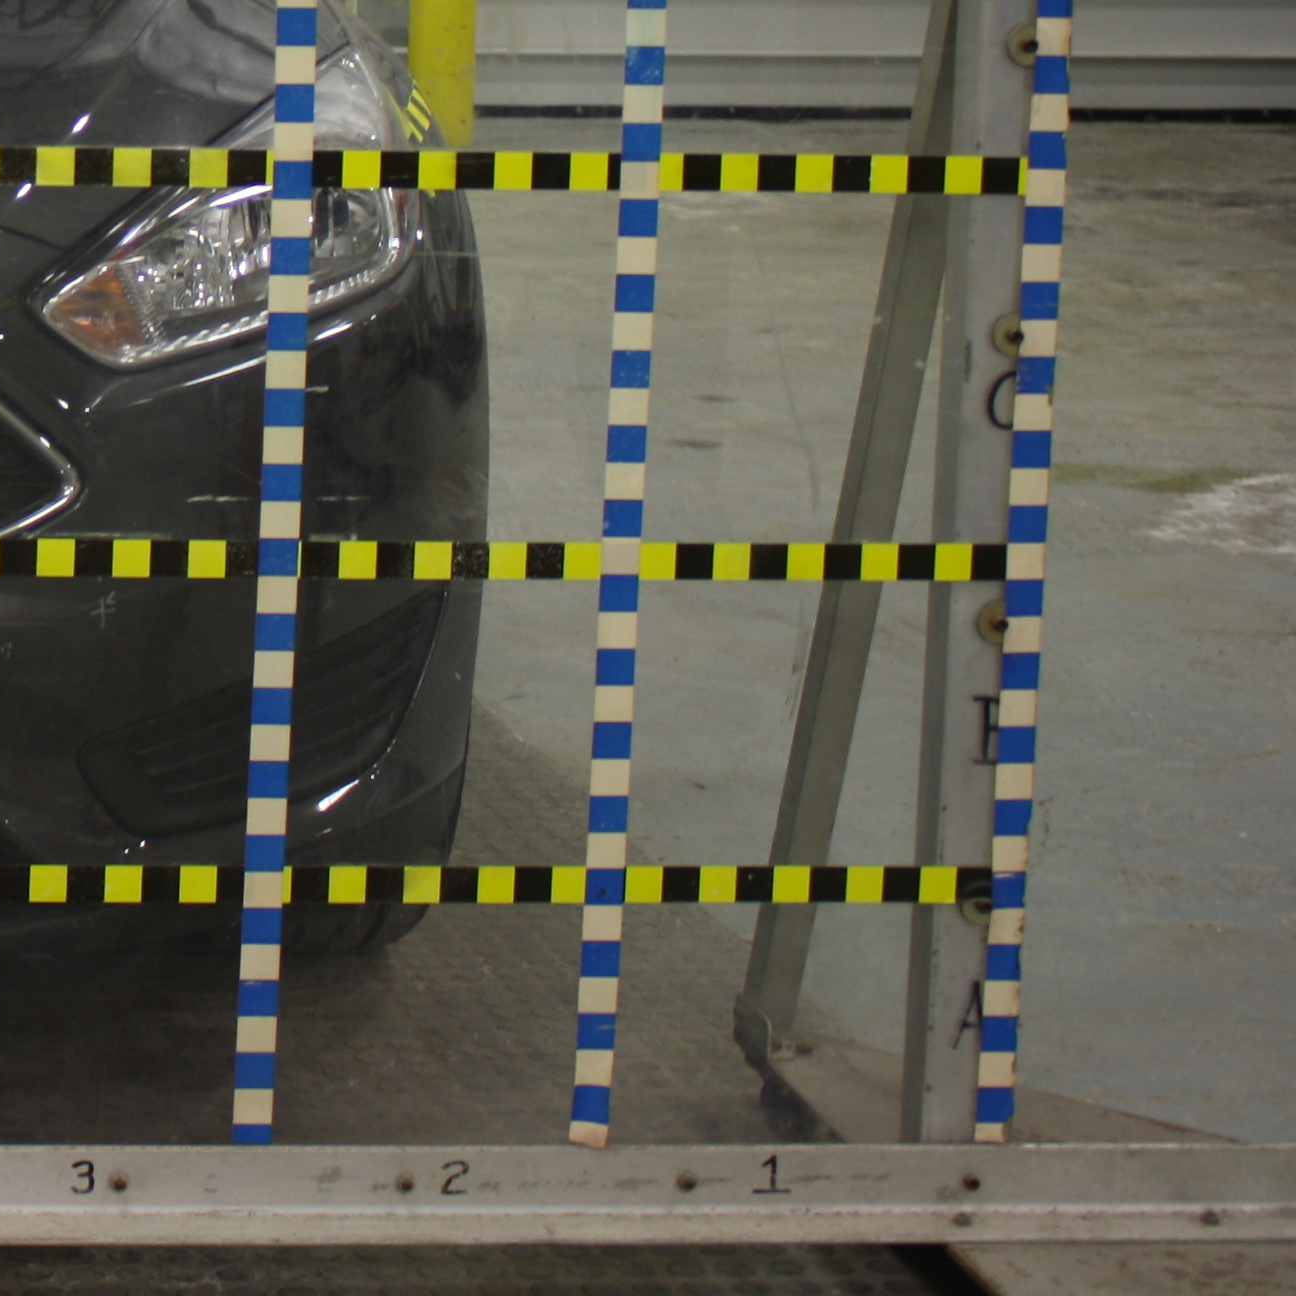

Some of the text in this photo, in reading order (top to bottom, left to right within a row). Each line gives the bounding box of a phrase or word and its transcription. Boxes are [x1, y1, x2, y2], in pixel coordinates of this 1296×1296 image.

[70, 1160, 96, 1194] 3
[440, 1160, 470, 1196] 2
[752, 1156, 791, 1194] 1
